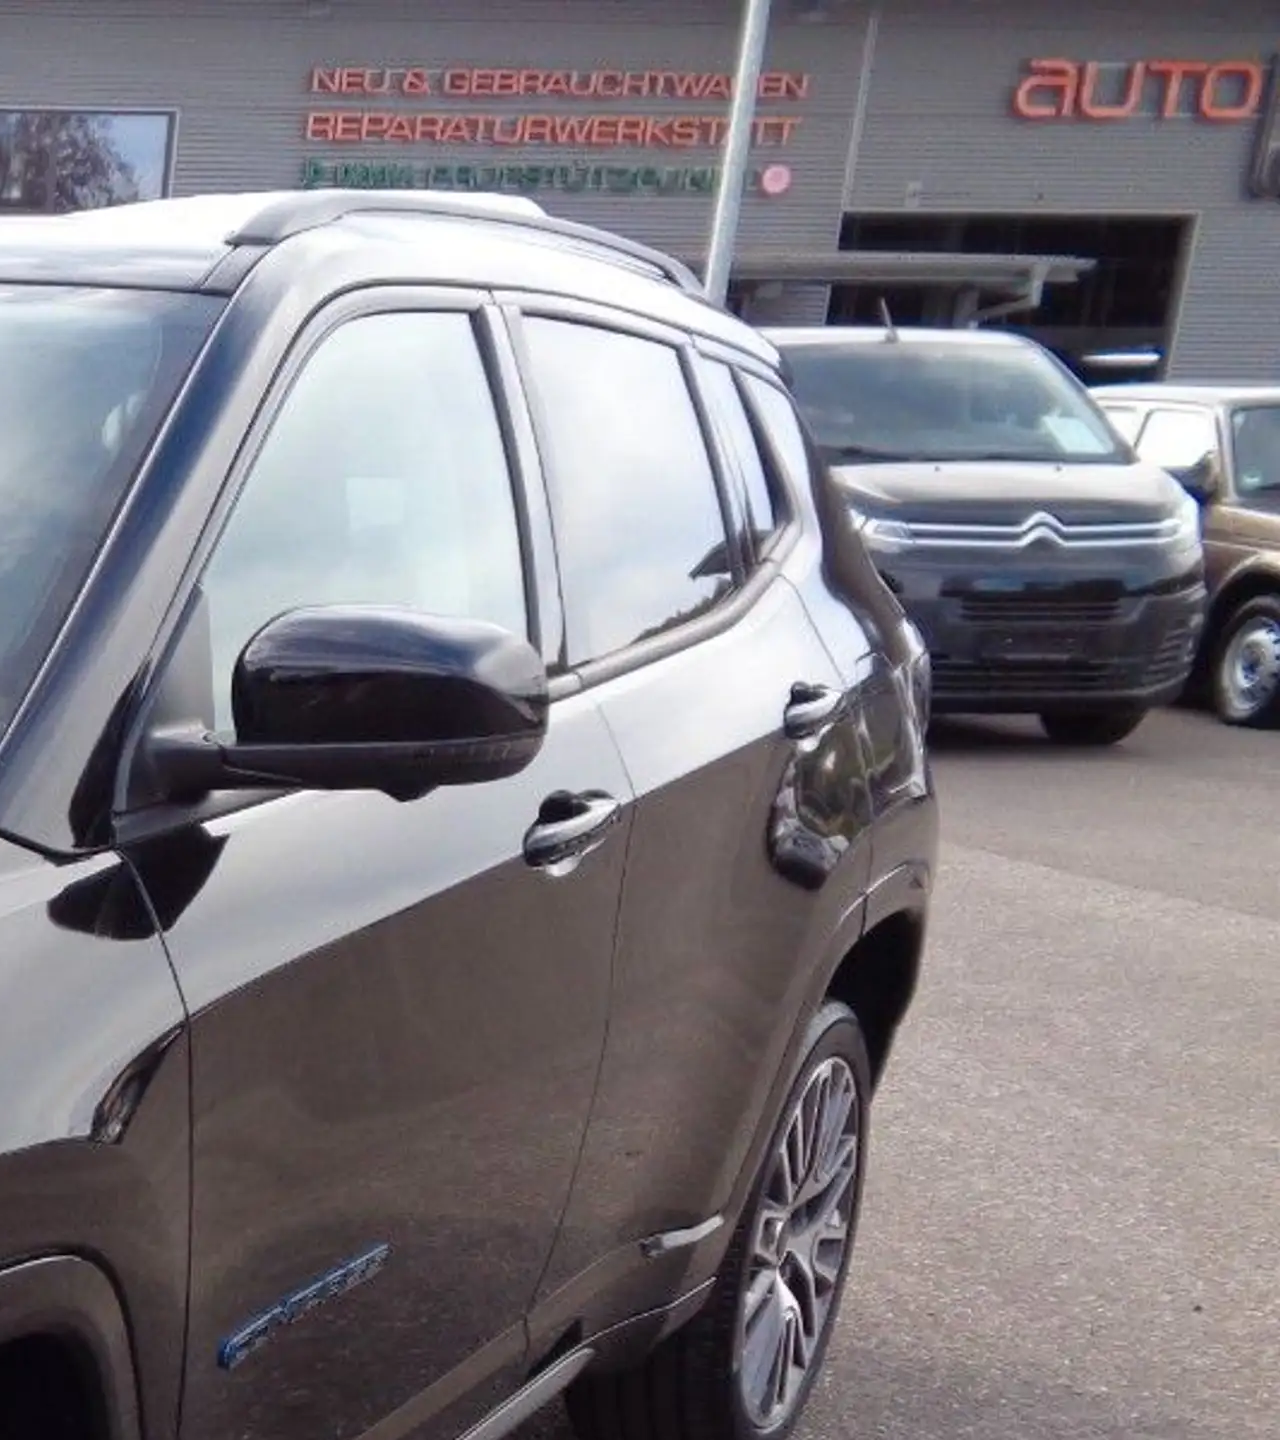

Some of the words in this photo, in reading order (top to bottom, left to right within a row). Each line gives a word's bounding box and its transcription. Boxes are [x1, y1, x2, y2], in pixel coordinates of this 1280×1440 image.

[311, 68, 390, 92] NEU
[403, 68, 430, 93] &
[444, 69, 808, 97] GEBRAUCHTWAEN
